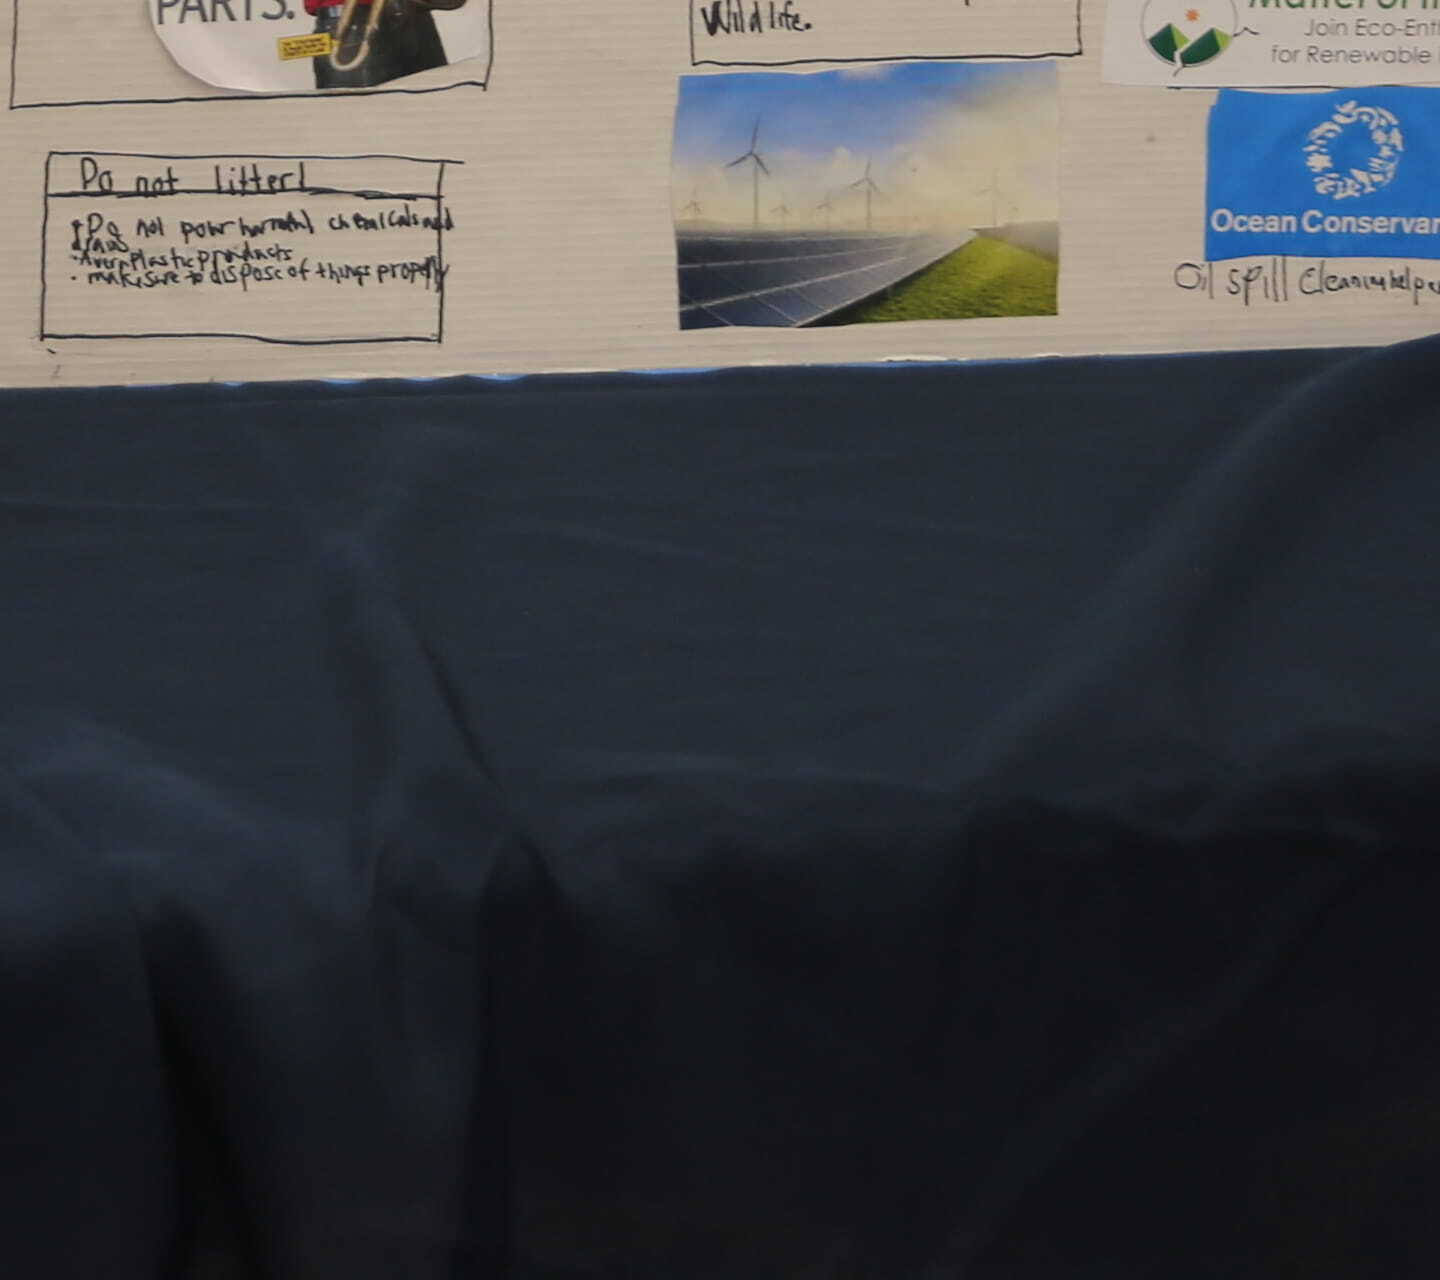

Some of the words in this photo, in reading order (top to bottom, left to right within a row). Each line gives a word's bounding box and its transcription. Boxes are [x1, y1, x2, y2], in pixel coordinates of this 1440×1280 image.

[1303, 18, 1348, 37] Join
[1271, 44, 1301, 64] for
[1306, 45, 1433, 65] Renewable
[136, 167, 179, 192] not
[1211, 207, 1297, 234] Ocean
